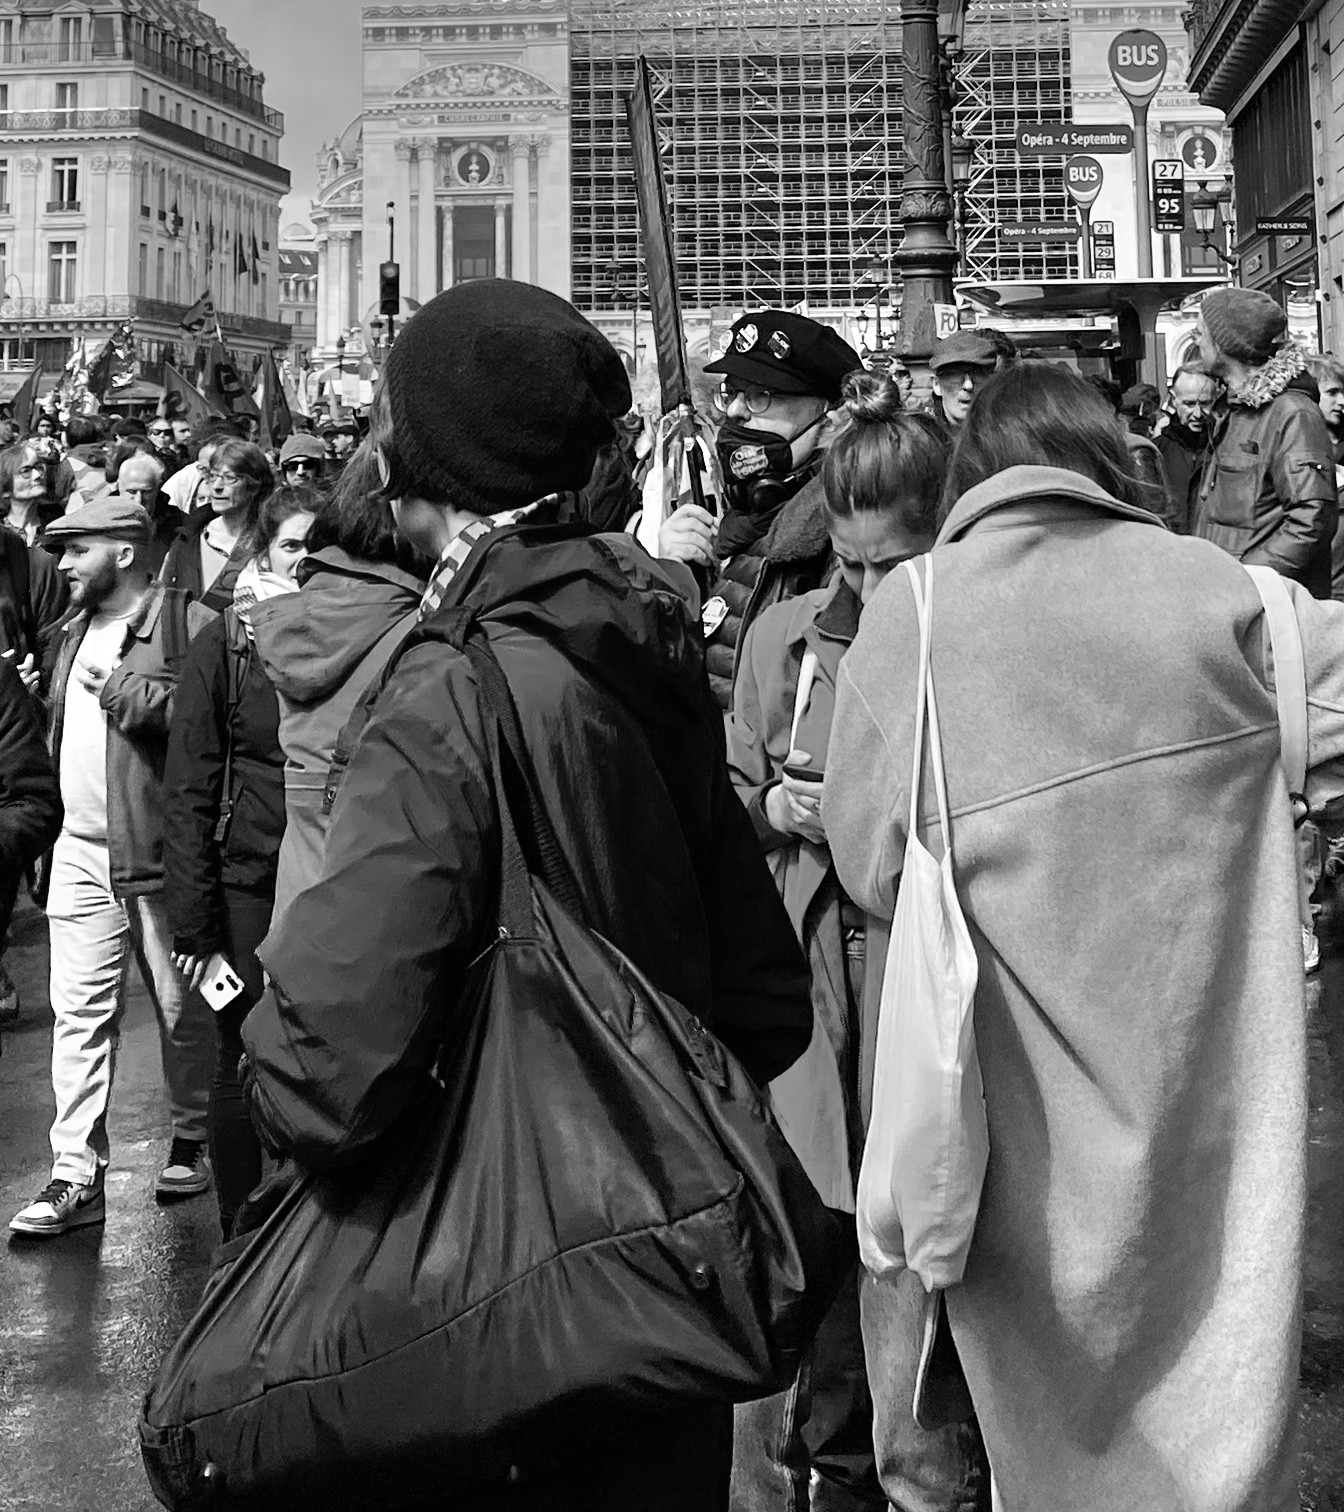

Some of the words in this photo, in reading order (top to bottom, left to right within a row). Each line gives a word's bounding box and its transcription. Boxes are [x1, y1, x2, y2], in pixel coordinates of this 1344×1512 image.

[1117, 45, 1159, 66] BUS
[1021, 133, 1054, 148] Opéra
[1061, 133, 1069, 146] 4
[1071, 132, 1128, 148] Septembre
[1068, 166, 1098, 182] BUS
[1158, 163, 1179, 177] 27
[1158, 198, 1180, 214] 95
[1003, 227, 1026, 237] Opéra
[1031, 227, 1036, 235] 4
[1037, 226, 1077, 237] Septembre
[1097, 223, 1110, 233] 21
[1097, 247, 1111, 258] 29
